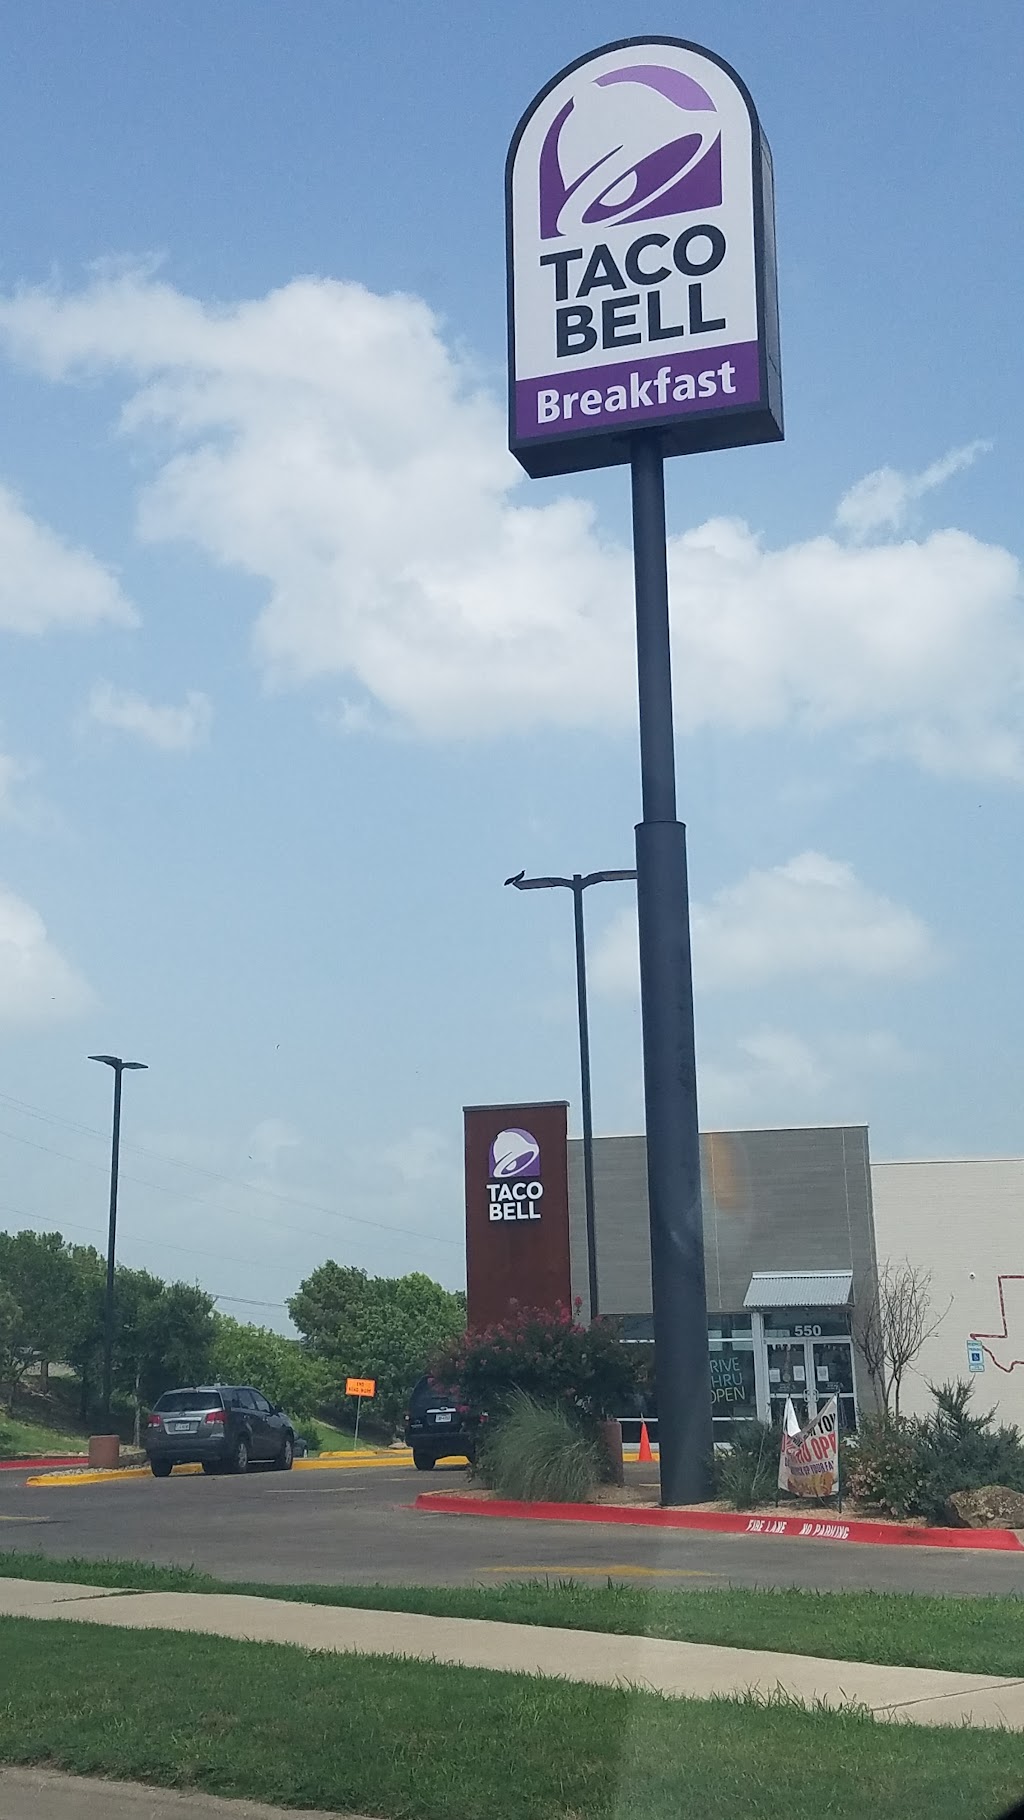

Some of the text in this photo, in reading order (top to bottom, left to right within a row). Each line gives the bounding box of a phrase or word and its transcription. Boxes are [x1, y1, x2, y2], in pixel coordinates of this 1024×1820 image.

[540, 223, 726, 302] TACO
[556, 283, 726, 358] BELL
[537, 360, 737, 424] Breakfast
[486, 1181, 544, 1202] TACO
[489, 1201, 541, 1221] BELL
[794, 1325, 822, 1337] 550
[709, 1356, 741, 1373] RIVE
[711, 1373, 743, 1388] HRU
[746, 1520, 765, 1531] FIRE
[765, 1521, 787, 1533] LANE
[799, 1523, 812, 1535] NO
